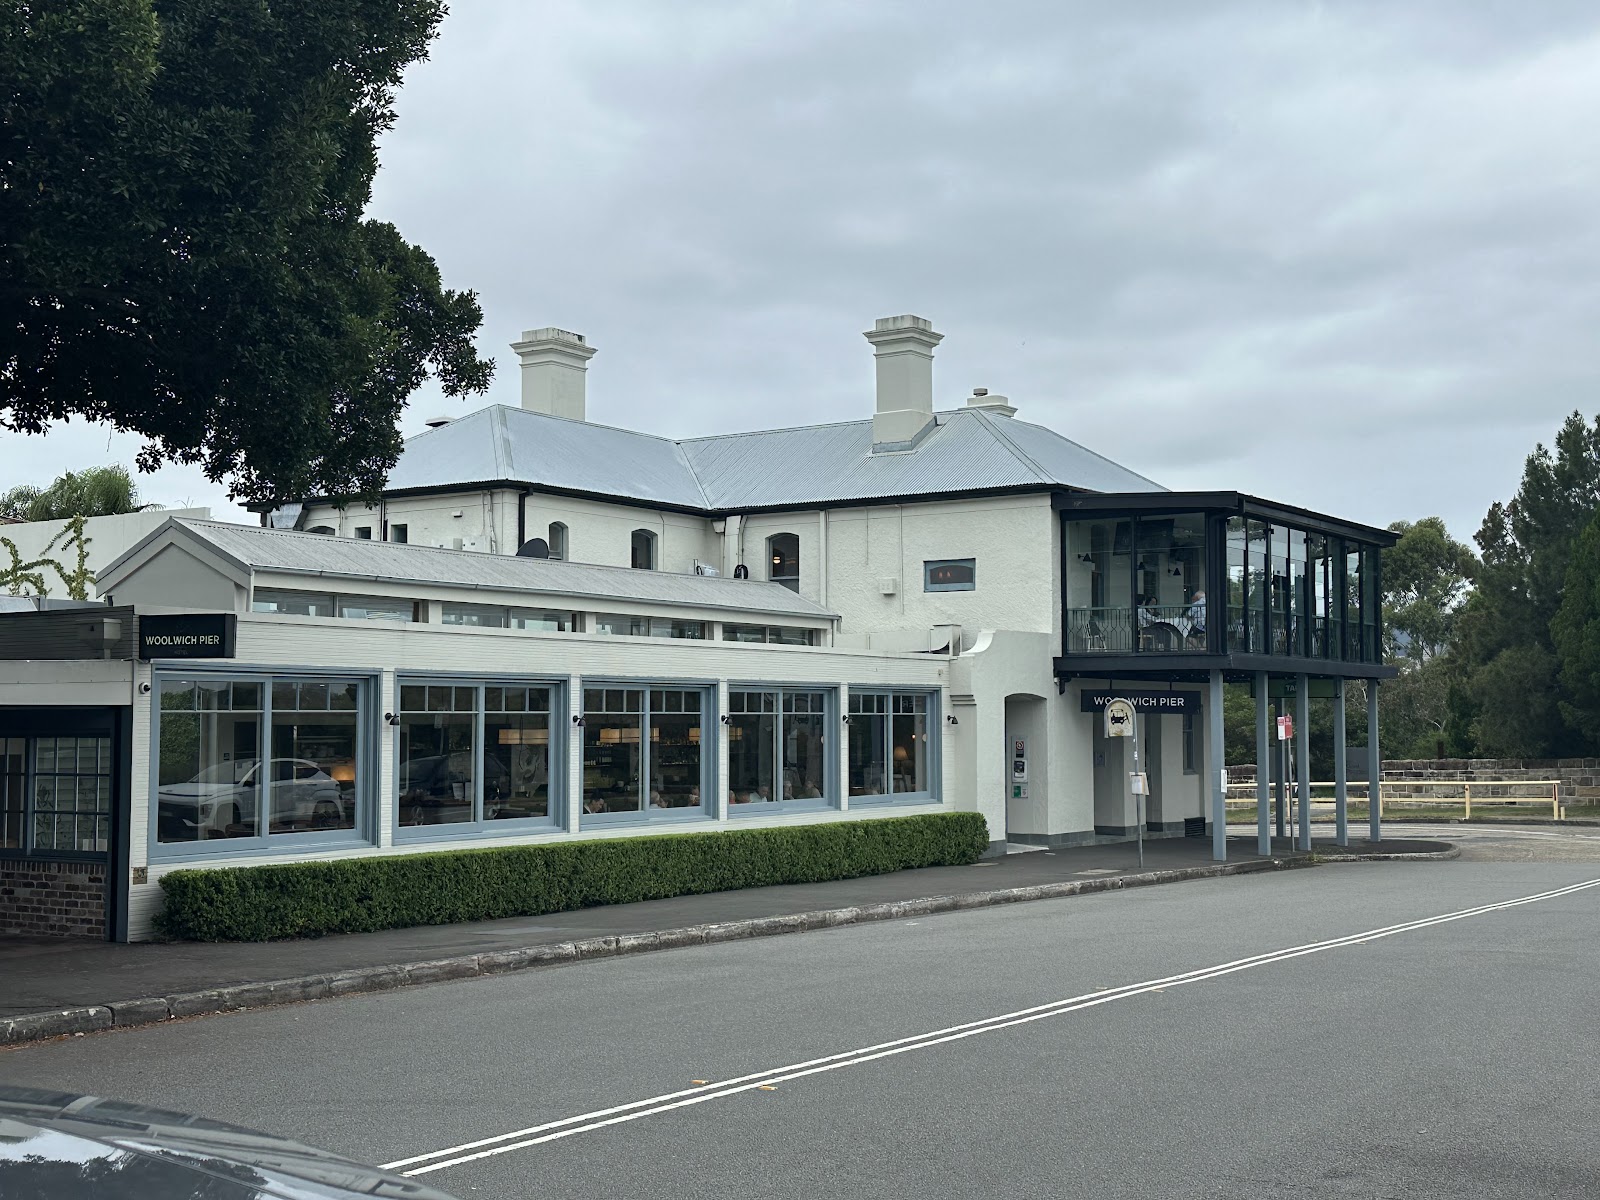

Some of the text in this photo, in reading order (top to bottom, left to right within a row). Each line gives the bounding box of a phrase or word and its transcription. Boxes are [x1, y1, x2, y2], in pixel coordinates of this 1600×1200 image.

[145, 634, 220, 646] WOOLWICH PIER
[1285, 684, 1297, 692] TA
[1093, 696, 1185, 707] WOWICH PIER
